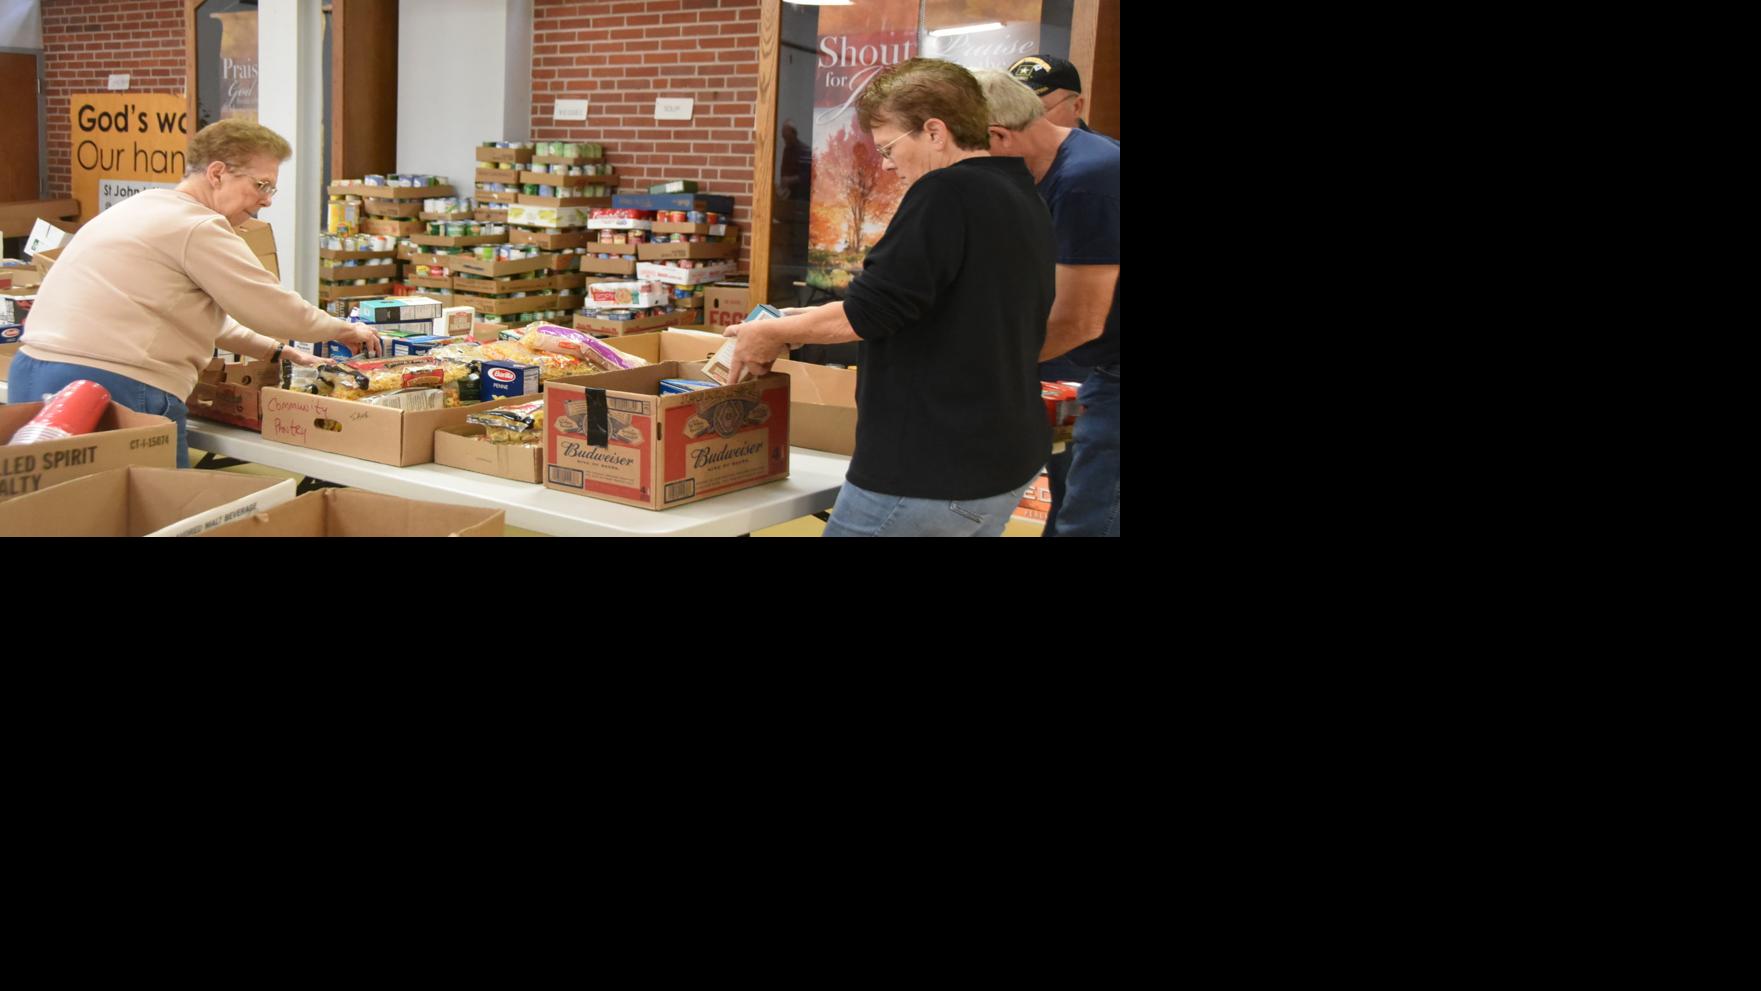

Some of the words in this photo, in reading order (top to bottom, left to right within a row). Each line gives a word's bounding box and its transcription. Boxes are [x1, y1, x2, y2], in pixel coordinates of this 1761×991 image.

[818, 35, 912, 68] Shout
[825, 71, 848, 88] for
[78, 104, 149, 133] God's
[77, 140, 125, 171] Our
[133, 141, 186, 174] han
[104, 184, 112, 196] St
[709, 310, 752, 328] EGG
[493, 382, 509, 390] PENNE
[0, 454, 36, 477] LED
[42, 446, 98, 471] SPIRIT
[561, 440, 634, 466] Budweiser
[690, 440, 765, 469] Budweiser
[224, 502, 257, 521] BEVERAGE
